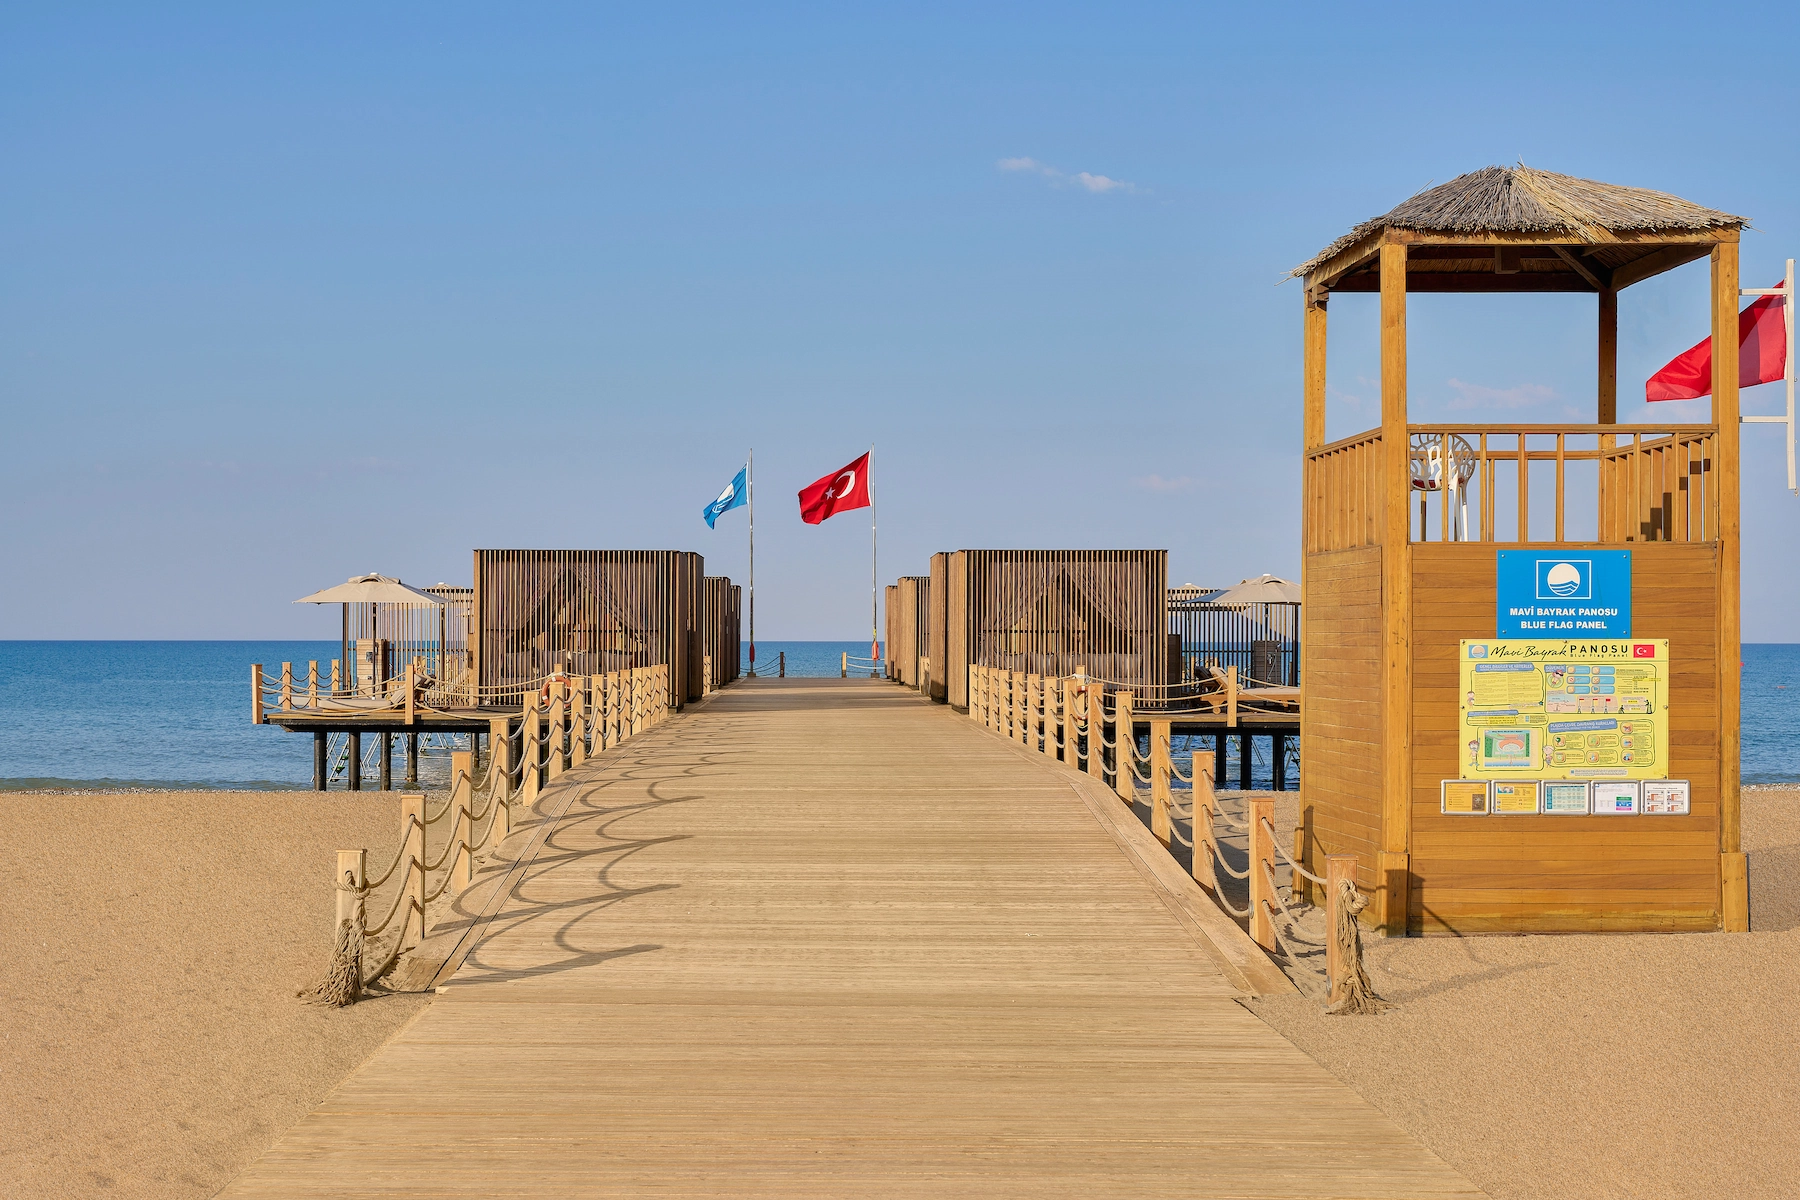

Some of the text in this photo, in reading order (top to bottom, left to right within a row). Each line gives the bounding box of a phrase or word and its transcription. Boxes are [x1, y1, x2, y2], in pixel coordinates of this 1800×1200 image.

[1510, 606, 1618, 616] MAVİ BAYRAK PANOSU
[1521, 621, 1607, 629] BLUE FLAG PANEL
[1490, 644, 1628, 660] Mavi Bayrak PANOSU
